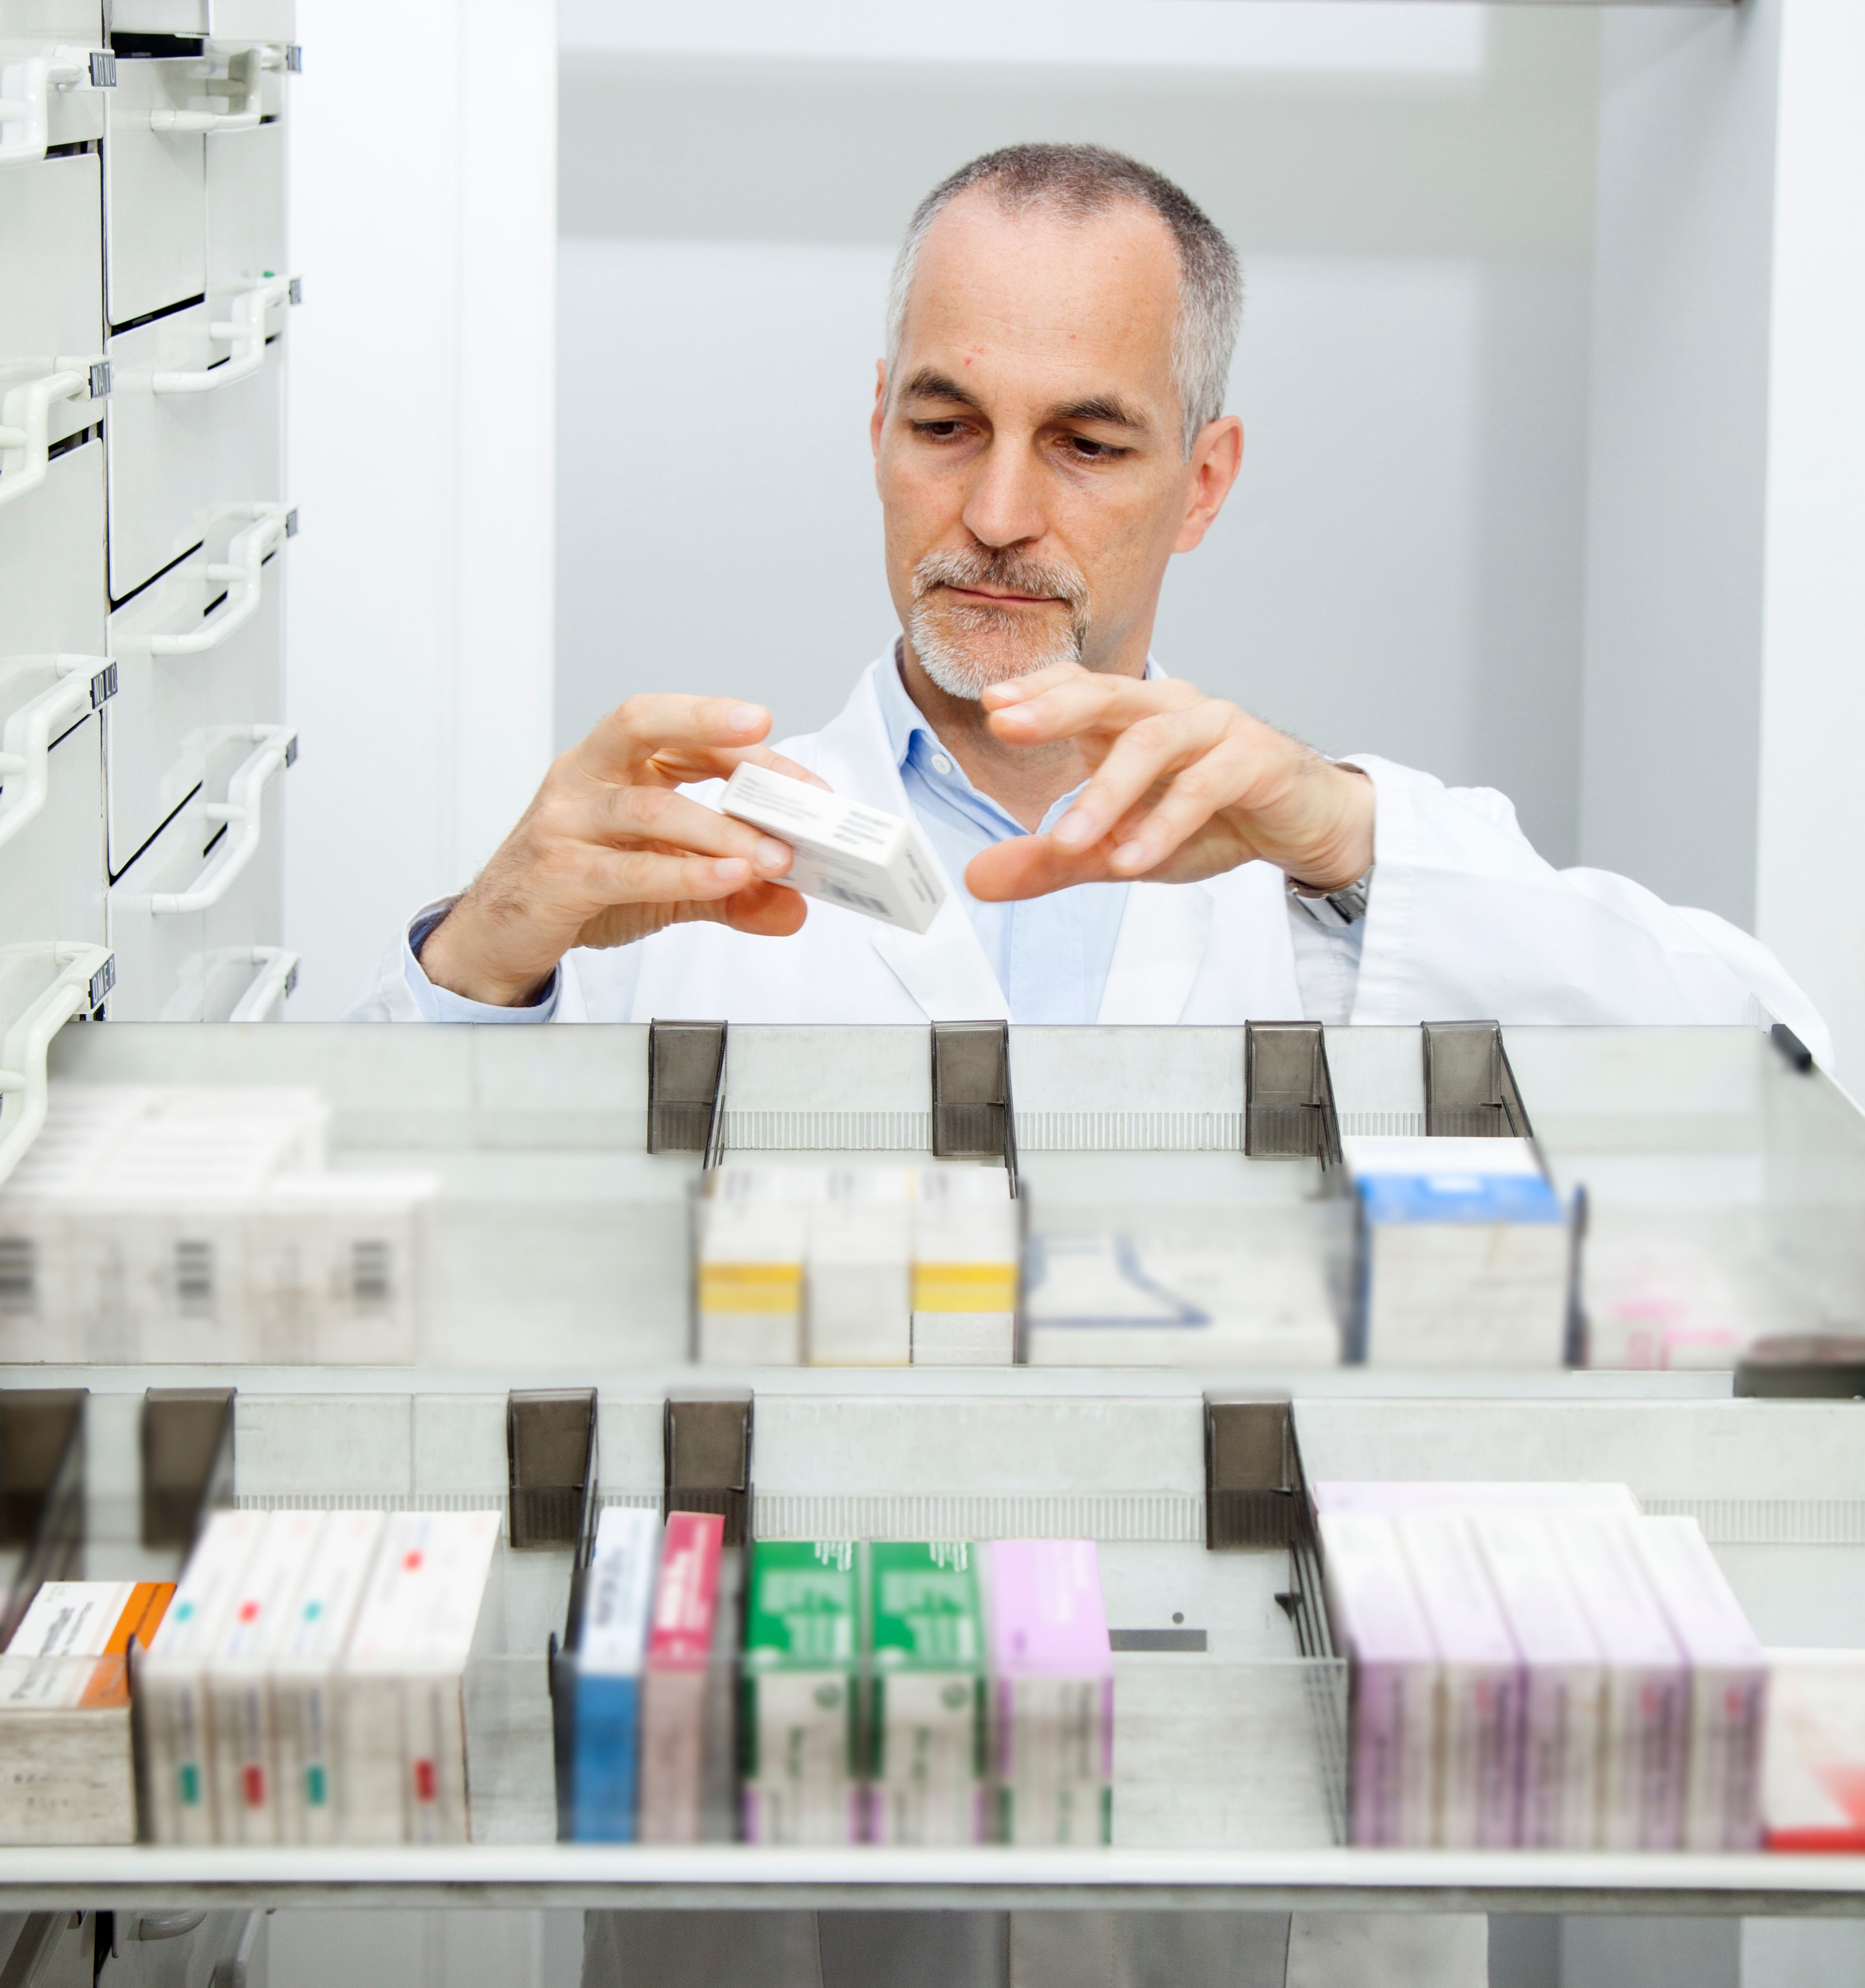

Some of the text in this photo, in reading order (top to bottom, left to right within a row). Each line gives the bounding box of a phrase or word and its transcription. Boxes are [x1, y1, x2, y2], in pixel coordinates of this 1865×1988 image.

[93, 55, 115, 85] MONU
[93, 364, 109, 395] NAT
[93, 959, 113, 1003] OMEP
